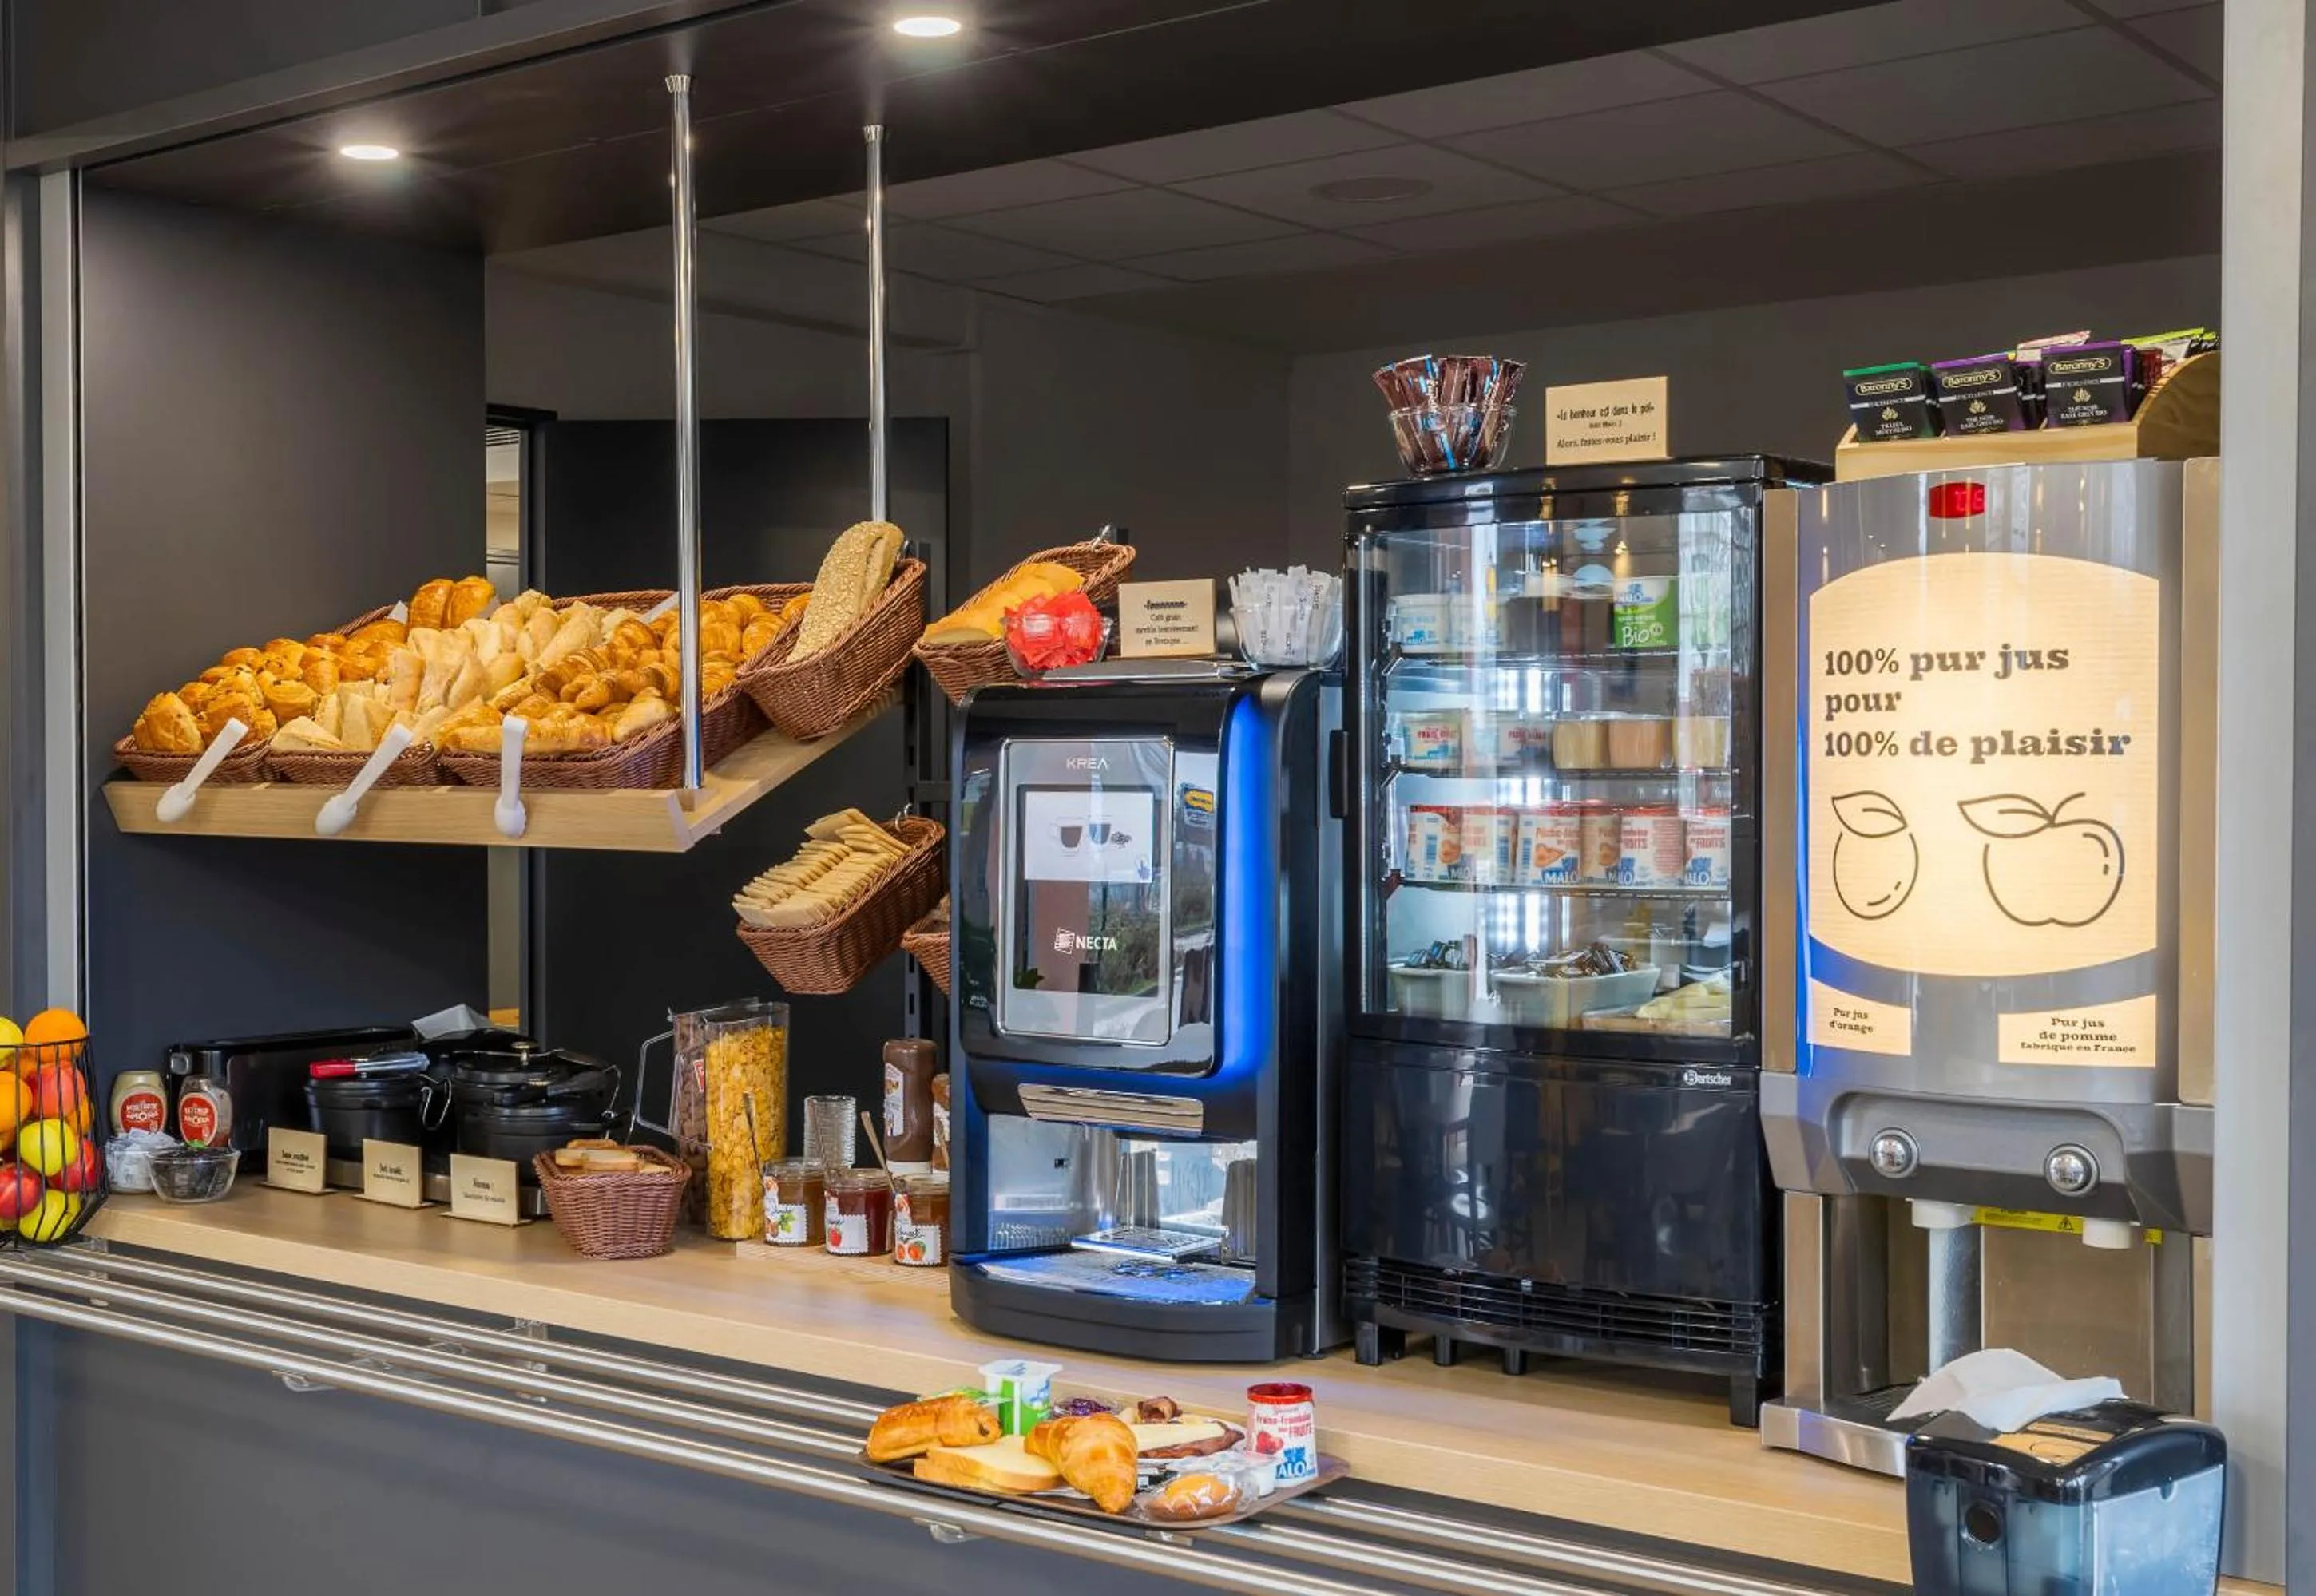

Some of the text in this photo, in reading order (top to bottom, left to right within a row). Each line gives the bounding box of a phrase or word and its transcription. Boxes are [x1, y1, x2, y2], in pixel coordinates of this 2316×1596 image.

[1622, 625, 1650, 648] Bio
[1825, 644, 2069, 681] 100% pur jus
[1825, 691, 1902, 720] pour
[1825, 728, 2132, 764] 100% de plaisir
[1075, 935, 1117, 951] NECTA
[1834, 1008, 1869, 1021] Pur jus
[1829, 1020, 1874, 1035] d'orange
[2051, 1017, 2105, 1030] Pur jus
[2039, 1031, 2118, 1042] de pomme
[2094, 1044, 2136, 1053] France
[1683, 1070, 1732, 1087] Bartscher
[1277, 1461, 1307, 1479] ALO
